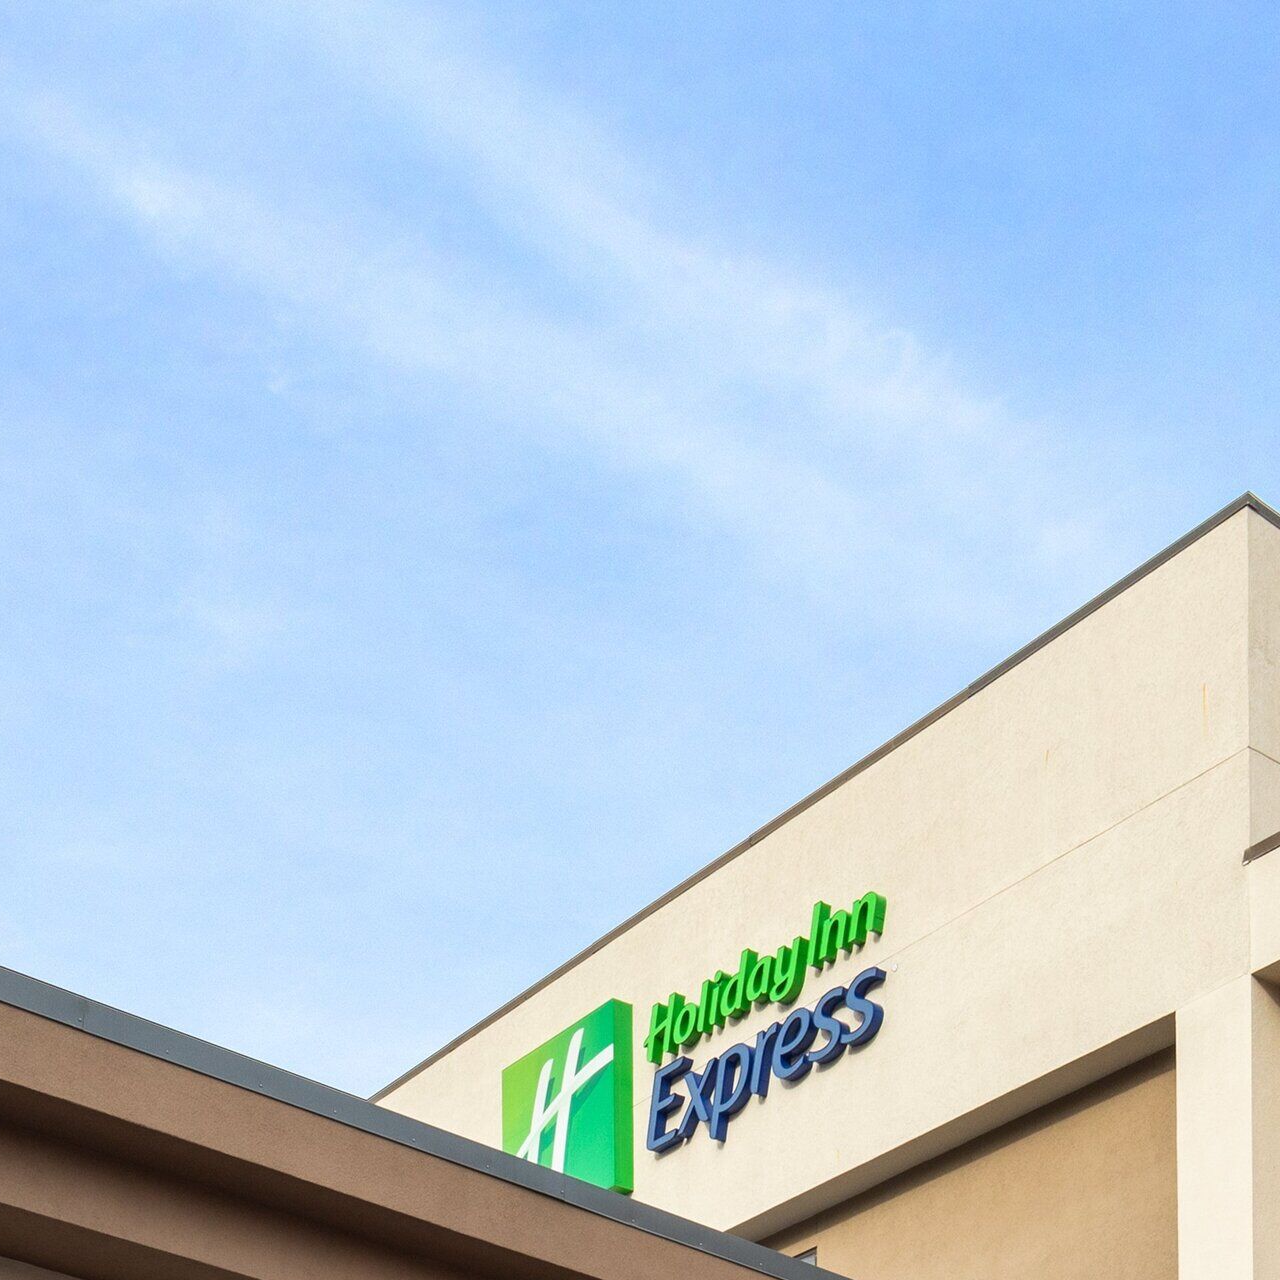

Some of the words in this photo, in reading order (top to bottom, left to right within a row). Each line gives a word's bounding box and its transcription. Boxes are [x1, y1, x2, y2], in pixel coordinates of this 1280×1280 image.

[644, 937, 808, 1064] Holiday
[807, 892, 887, 969] Inn
[647, 967, 887, 1153] Express
